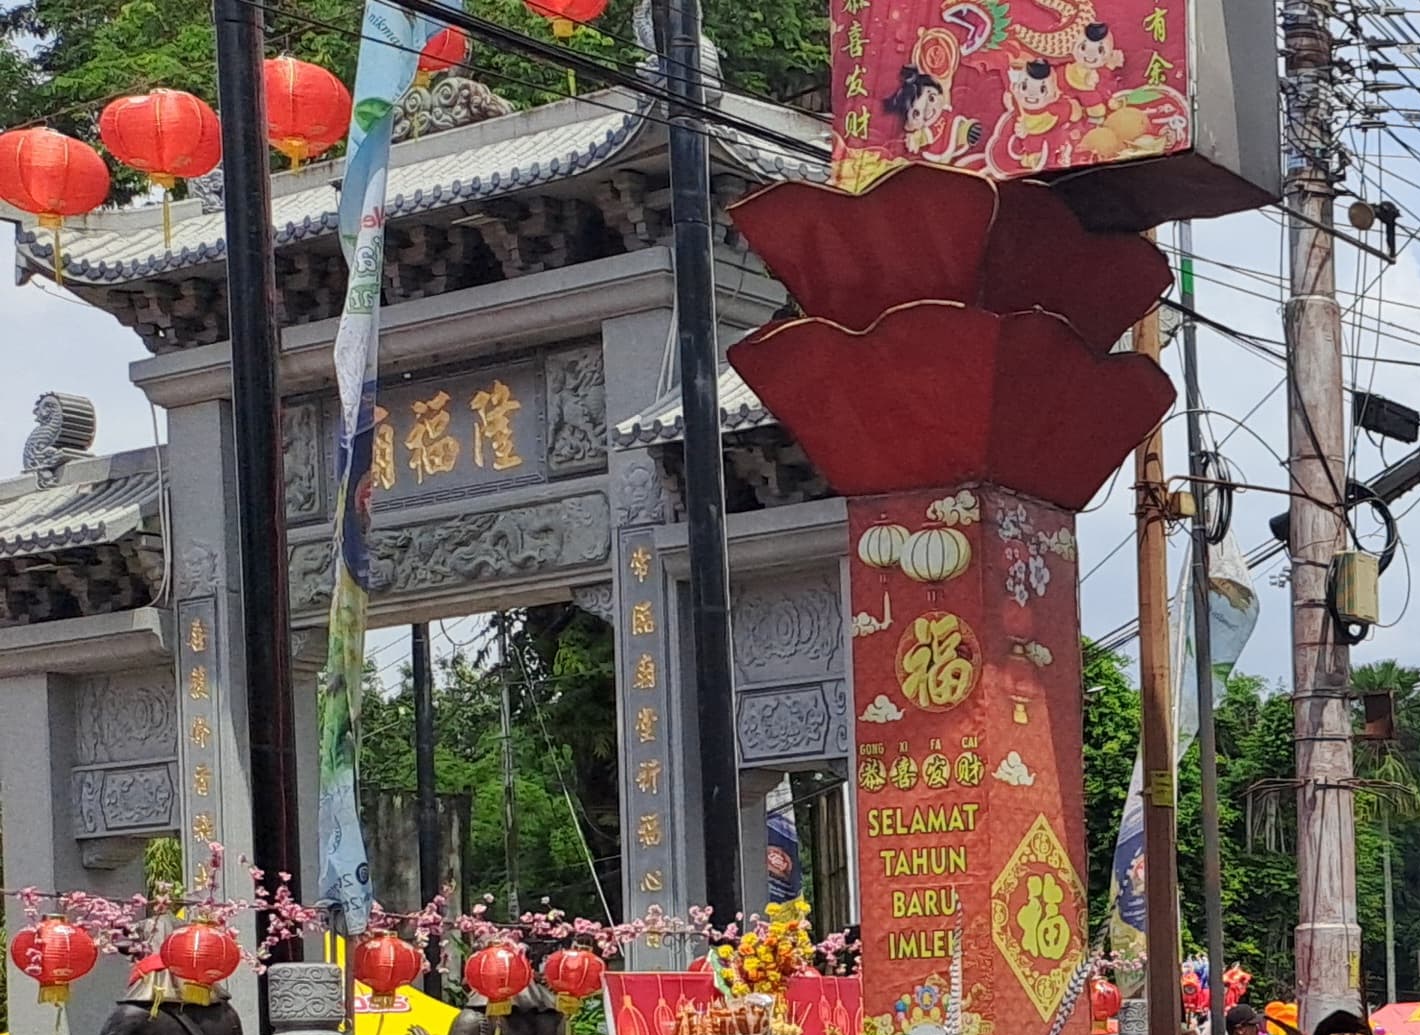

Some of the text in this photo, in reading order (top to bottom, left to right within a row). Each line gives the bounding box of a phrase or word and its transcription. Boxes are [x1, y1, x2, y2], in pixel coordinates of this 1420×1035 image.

[1143, 0, 1173, 86] 有余
[901, 614, 974, 707] 福
[859, 743, 885, 755] GONG
[930, 738, 942, 750] FA
[961, 736, 978, 749] CAI
[868, 804, 979, 838] SELAMAT
[880, 846, 967, 877] TAHUN
[892, 889, 958, 919] BARU
[1017, 872, 1071, 960] 福
